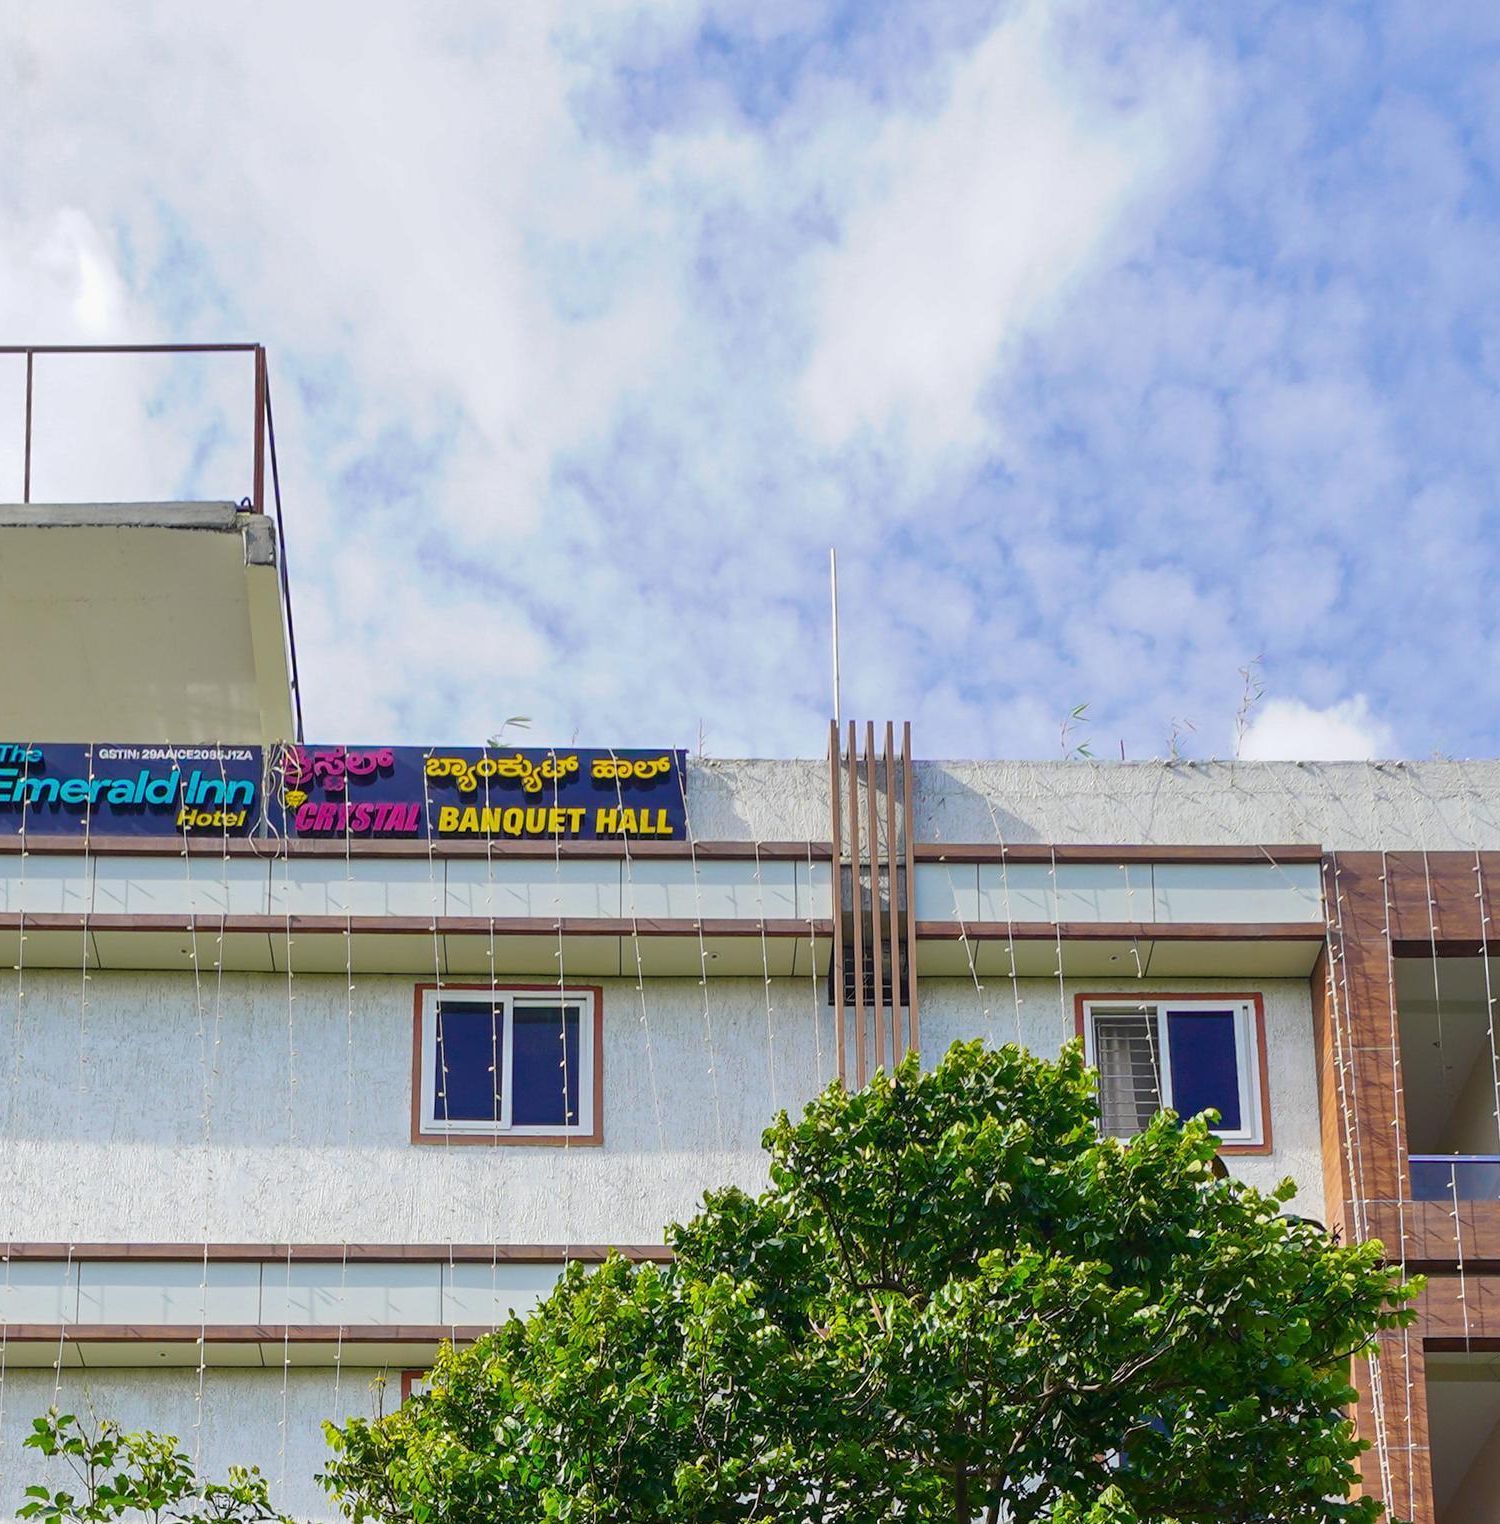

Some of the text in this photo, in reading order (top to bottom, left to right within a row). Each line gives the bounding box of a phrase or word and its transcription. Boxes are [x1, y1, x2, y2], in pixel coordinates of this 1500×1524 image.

[99, 749, 141, 760] GSTIN:
[186, 770, 256, 805] Inn
[176, 809, 248, 828] Hotel
[295, 802, 420, 831] CRYSTAL
[438, 806, 673, 836] BANQUET HALL
